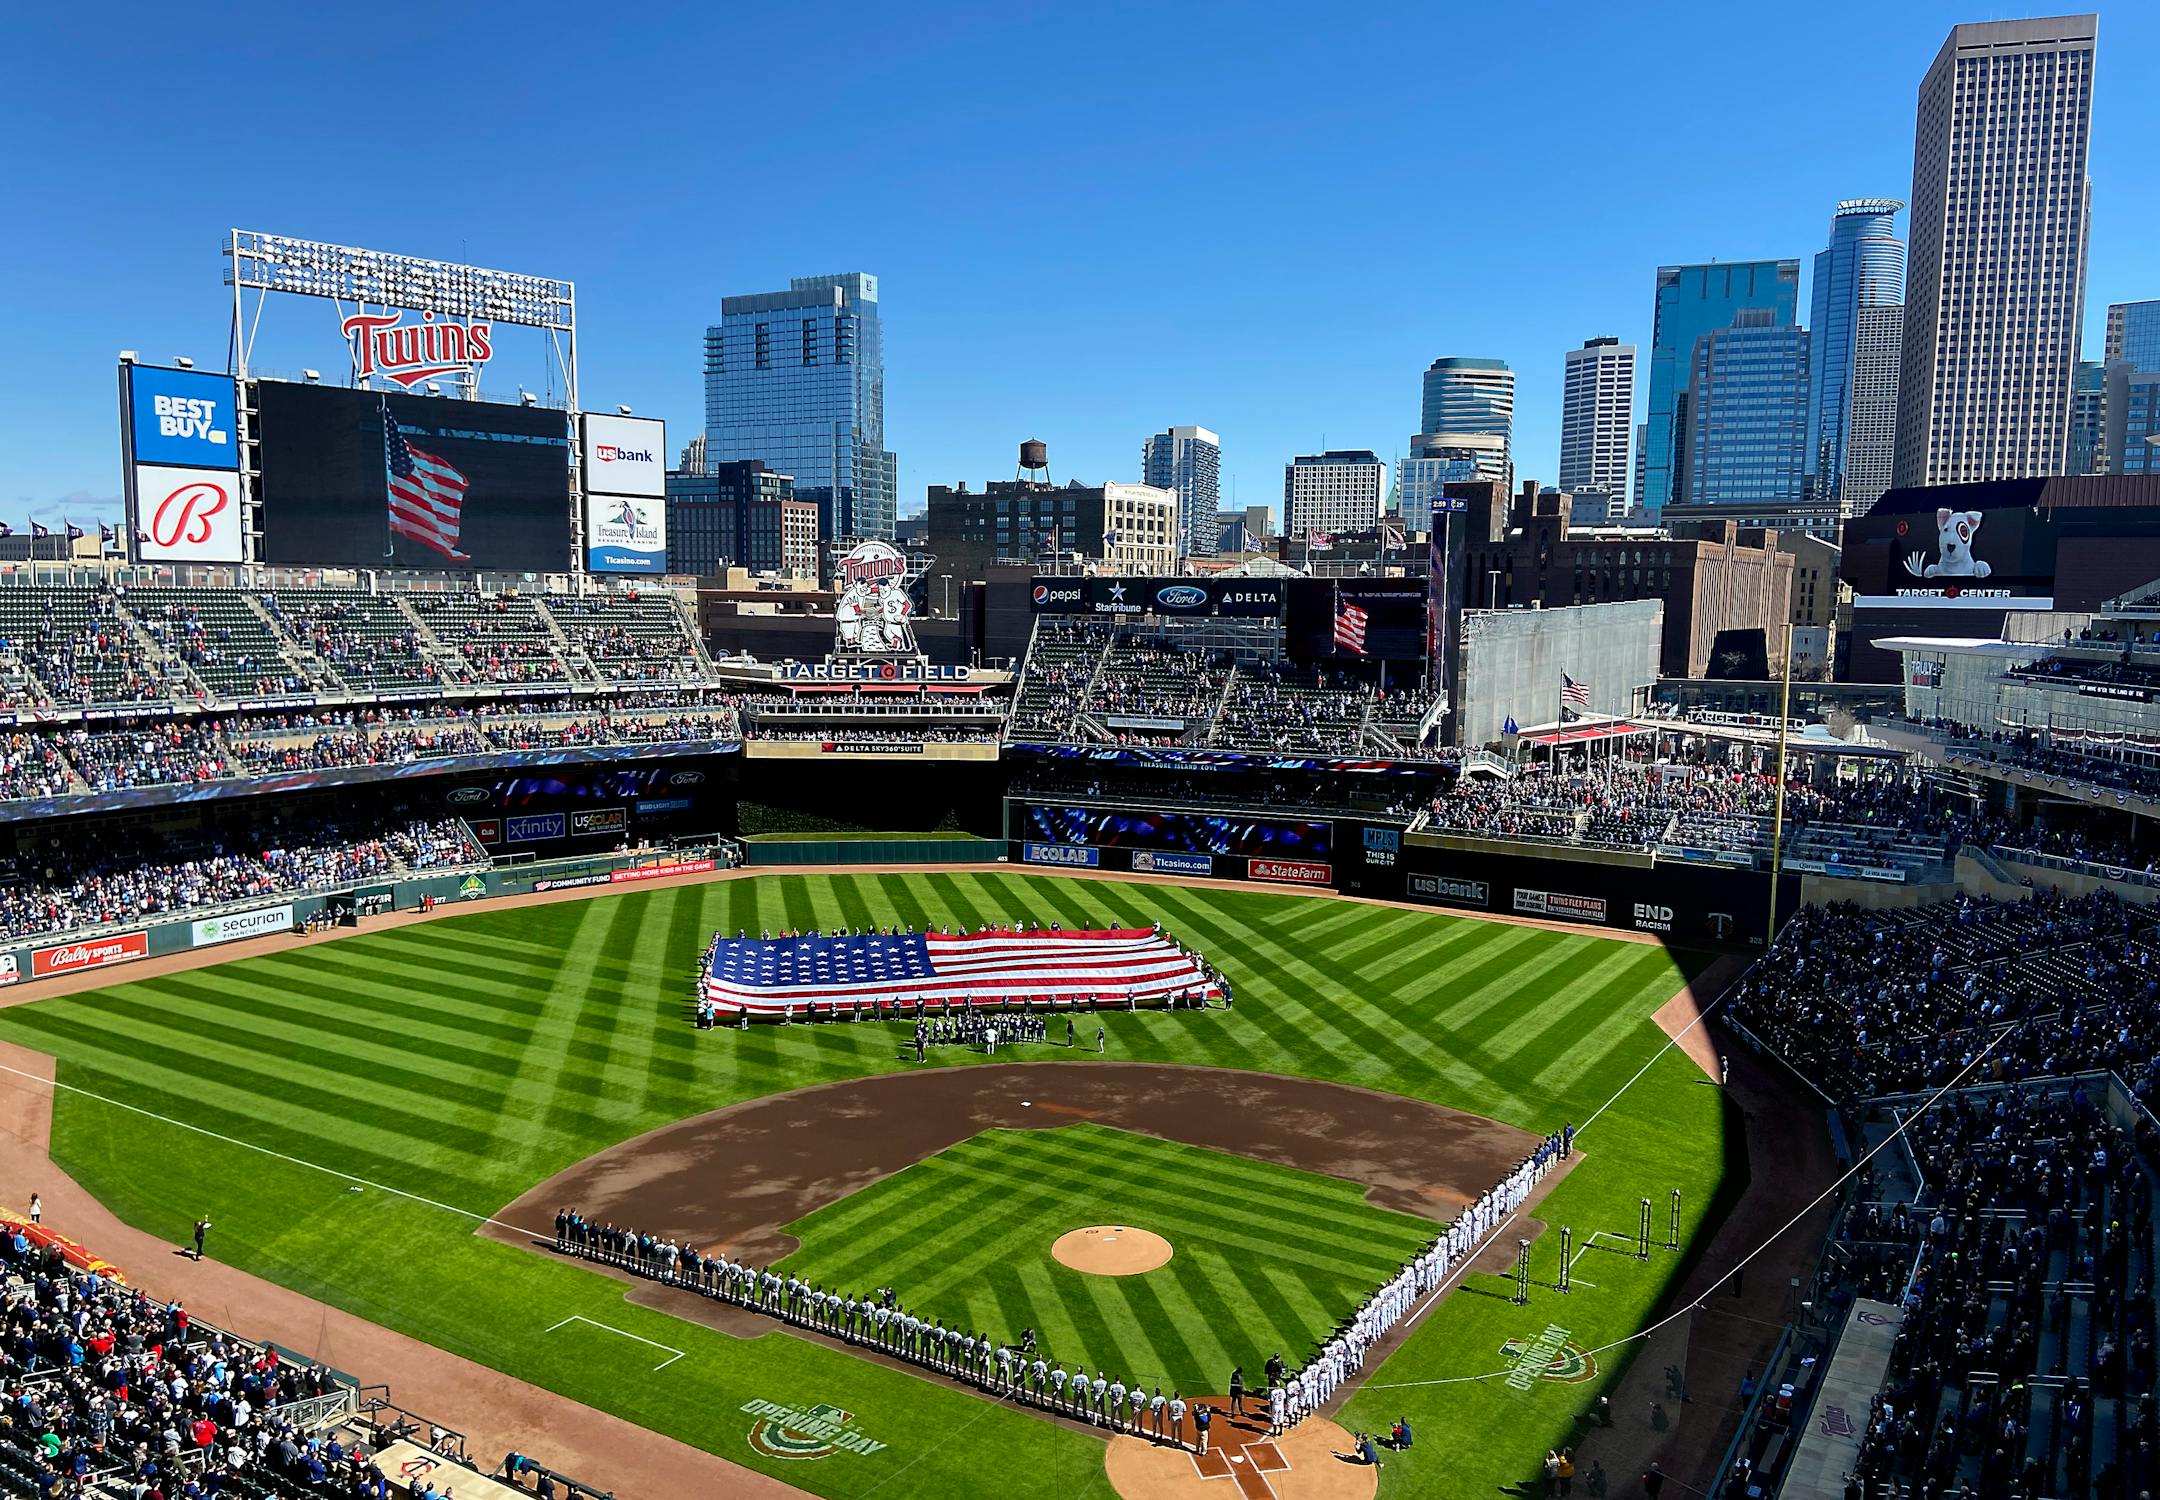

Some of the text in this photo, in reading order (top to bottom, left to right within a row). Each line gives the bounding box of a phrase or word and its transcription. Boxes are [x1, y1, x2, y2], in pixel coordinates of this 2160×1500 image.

[342, 310, 493, 381] Twins
[154, 395, 216, 421] BEST
[160, 415, 211, 439] BUY
[153, 483, 228, 547] B
[597, 525, 658, 539] Treasure Island
[838, 554, 905, 584] Twins
[1050, 589, 1081, 602] pepsi
[1166, 588, 1197, 604] Ford
[1236, 592, 1276, 602] DELTA
[1896, 588, 2011, 598] TARGET CENTER
[783, 665, 970, 680] TARGET FIELD
[151, 707, 170, 715] Porch
[1688, 711, 1806, 728] TARGET FIELD
[1140, 761, 1171, 769] TREASURE
[1174, 762, 1197, 770] ISLAND
[676, 773, 698, 784] Ford
[455, 791, 481, 801] Ford
[511, 818, 561, 838] xfinity
[1367, 831, 1394, 846] MPLS
[1031, 846, 1088, 863] ECOLAB
[1366, 851, 1386, 859] THIS
[1380, 859, 1395, 867] CITY
[614, 872, 641, 880] GETTING
[641, 869, 660, 877] MORE
[660, 867, 675, 875] KIDS
[552, 877, 592, 888] COMMUNITY
[592, 874, 610, 883] FUND
[433, 896, 446, 904] 377
[1550, 896, 1602, 910] TWINS FLEX PLANS
[1634, 903, 1674, 921] END
[223, 911, 284, 932] securian
[1635, 920, 1671, 931] RACISM
[223, 928, 259, 939] FINANCIAL
[50, 946, 93, 967] Bally
[92, 944, 123, 958] SPORTS
[1504, 1323, 1572, 1391] OPENING DAY
[740, 1398, 888, 1456] OPENING DAY
